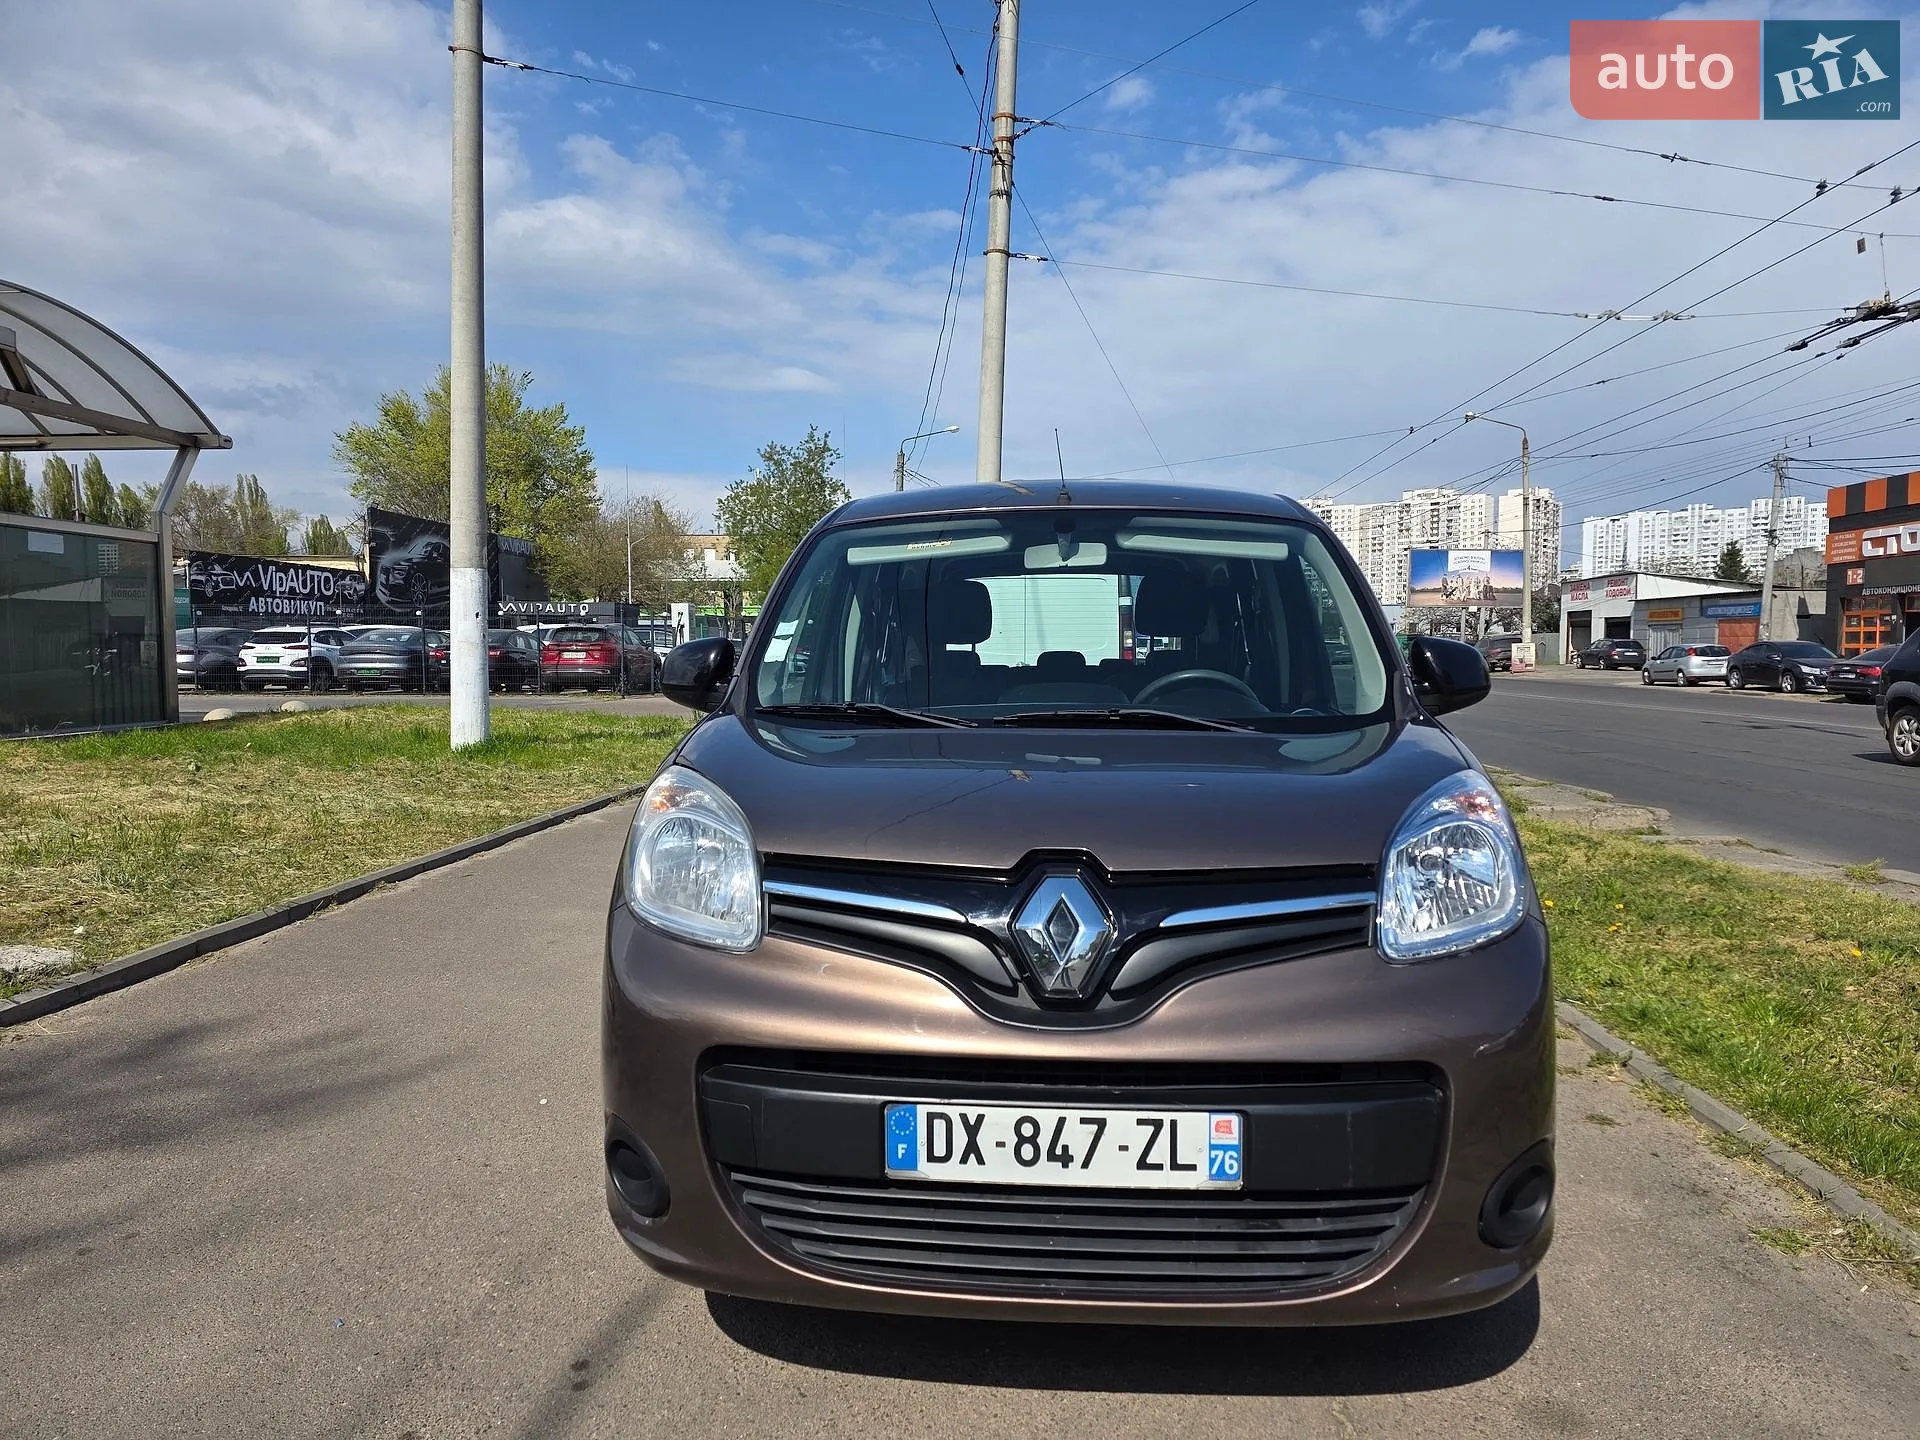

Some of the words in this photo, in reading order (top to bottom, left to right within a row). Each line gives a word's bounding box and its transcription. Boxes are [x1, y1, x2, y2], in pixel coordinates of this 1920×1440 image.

[1862, 524, 1920, 557] СТО
[257, 563, 334, 596] VipAUTO
[249, 596, 325, 615] АВТОВИКУП
[1571, 592, 1589, 600] МАСЛА
[897, 1143, 908, 1159] F
[926, 1111, 1198, 1172] DX-847-ZL
[1211, 1150, 1239, 1175] 76
